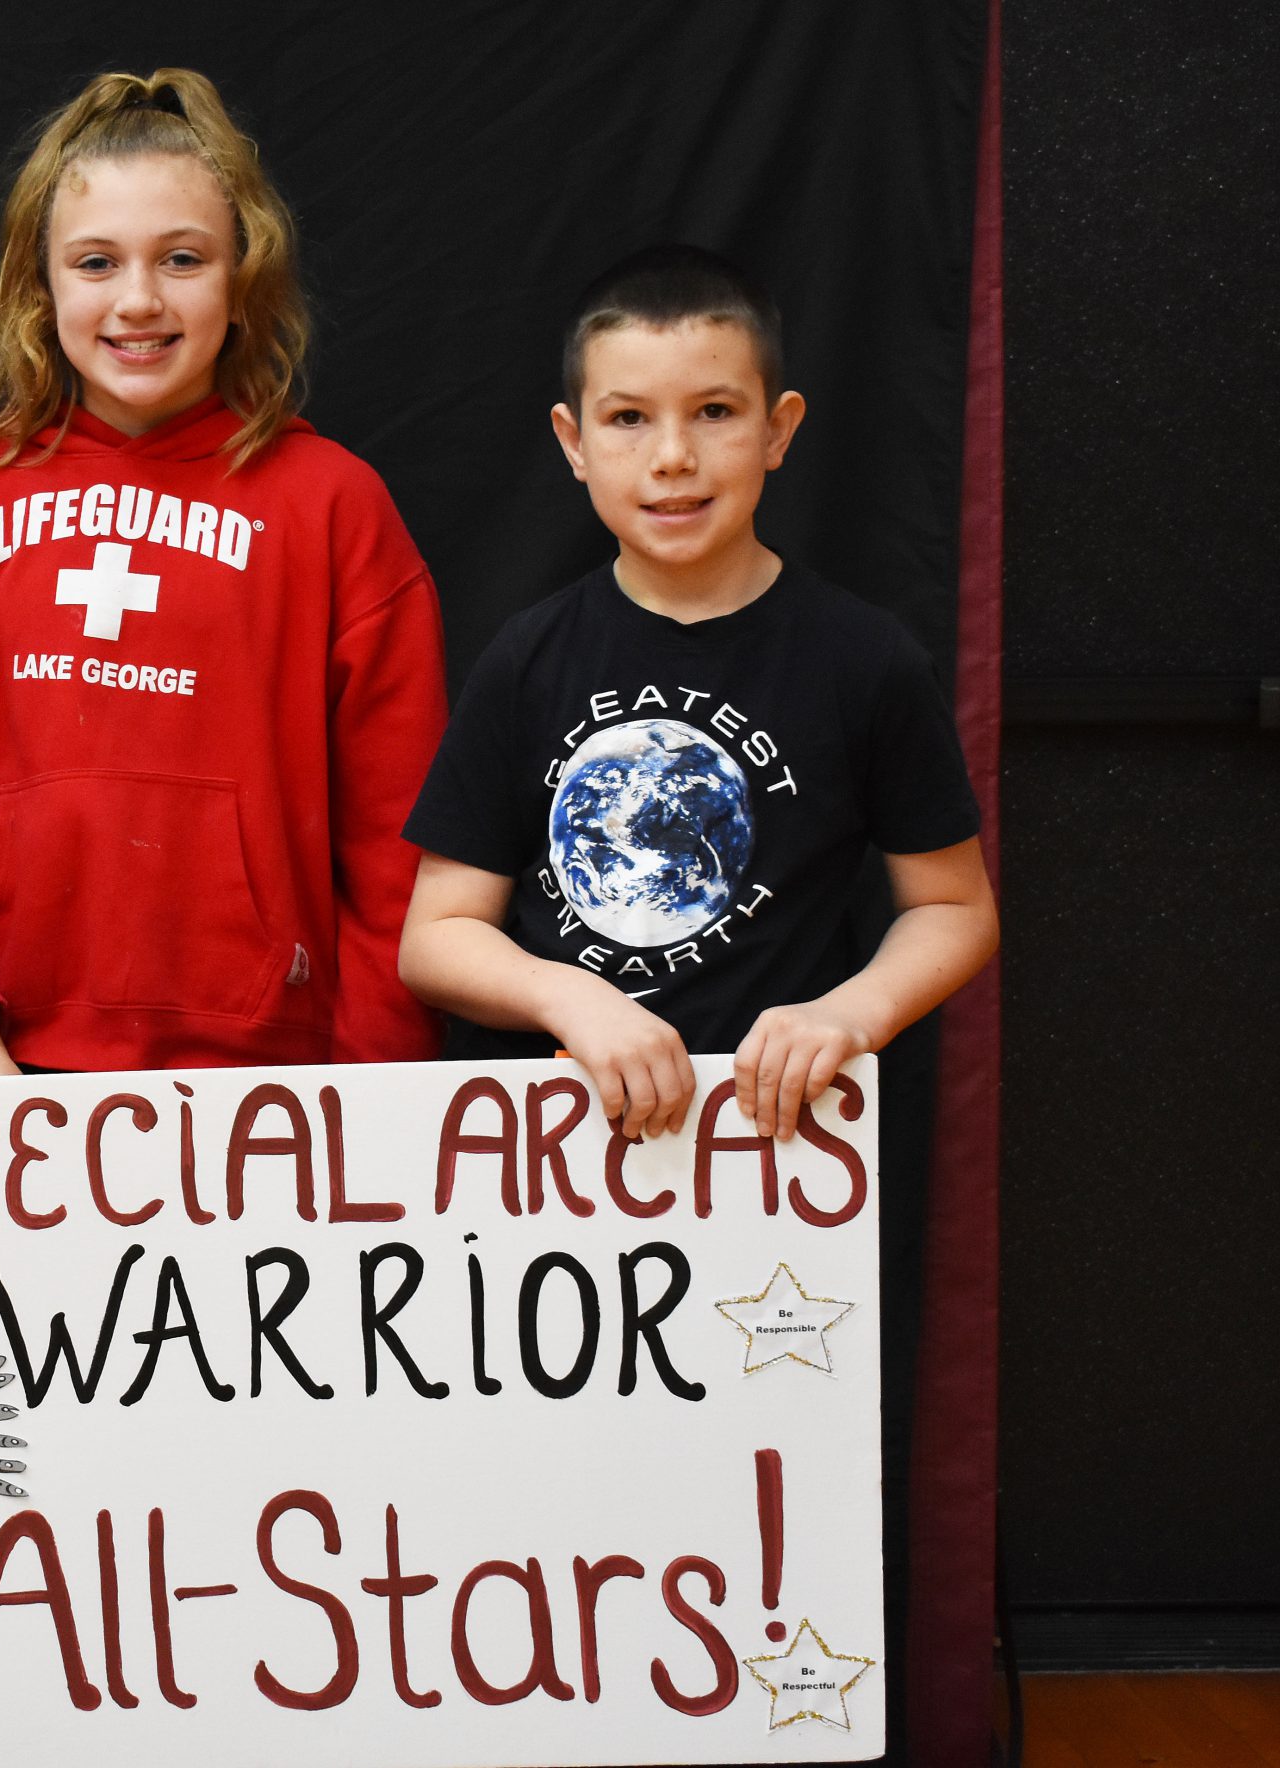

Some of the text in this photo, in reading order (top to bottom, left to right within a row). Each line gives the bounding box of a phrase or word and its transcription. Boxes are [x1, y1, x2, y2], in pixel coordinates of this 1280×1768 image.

[13, 654, 197, 696] LAKE GEORGE
[578, 884, 774, 977] EARTH
[434, 1072, 867, 1227] AREAS
[778, 1309, 794, 1318] Be
[756, 1325, 817, 1335] Responsible
[801, 1667, 816, 1676] Be
[782, 1682, 836, 1691] Respectful
